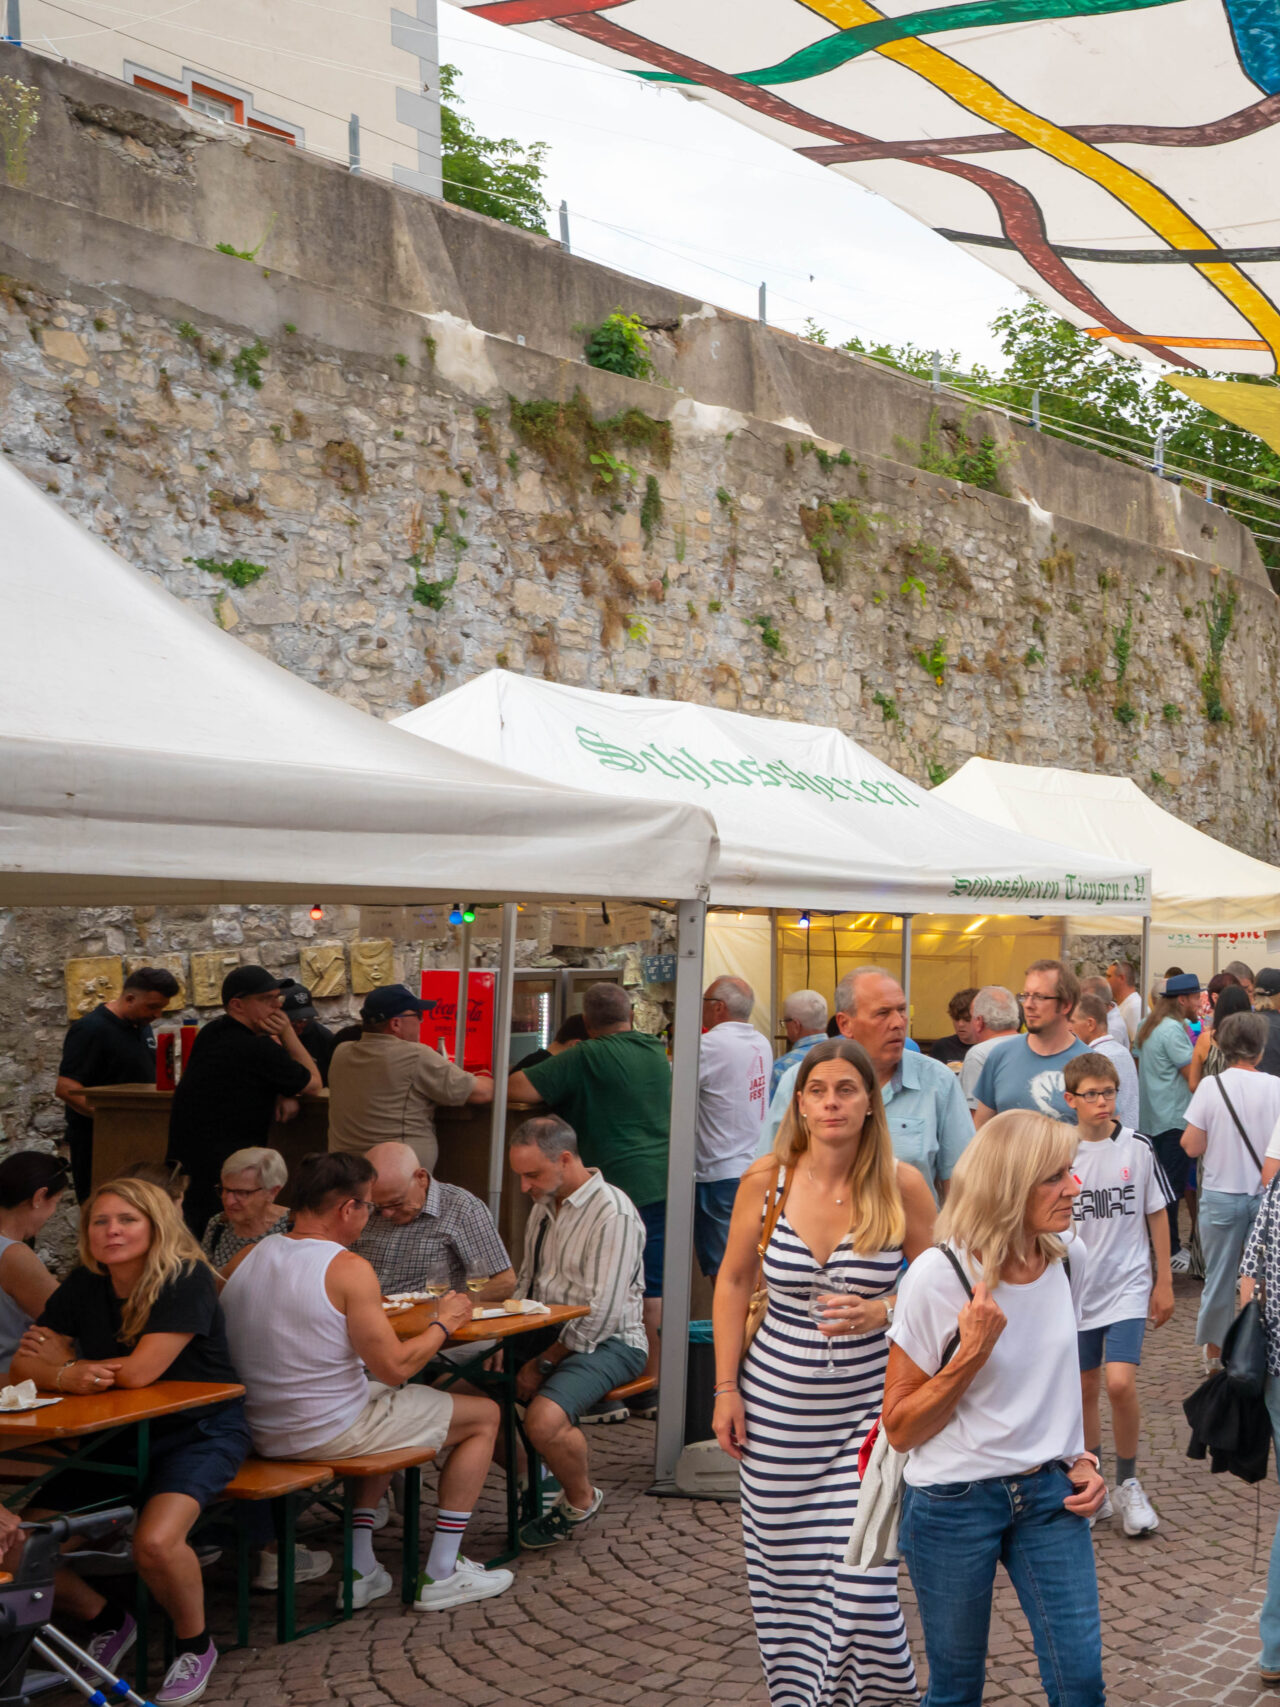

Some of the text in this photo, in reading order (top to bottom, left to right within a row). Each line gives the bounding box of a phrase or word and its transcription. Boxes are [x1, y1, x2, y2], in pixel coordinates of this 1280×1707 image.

[1065, 873, 1119, 905] Tiengen
[749, 1075, 765, 1091] JAZZ
[749, 1086, 765, 1102] FEST
